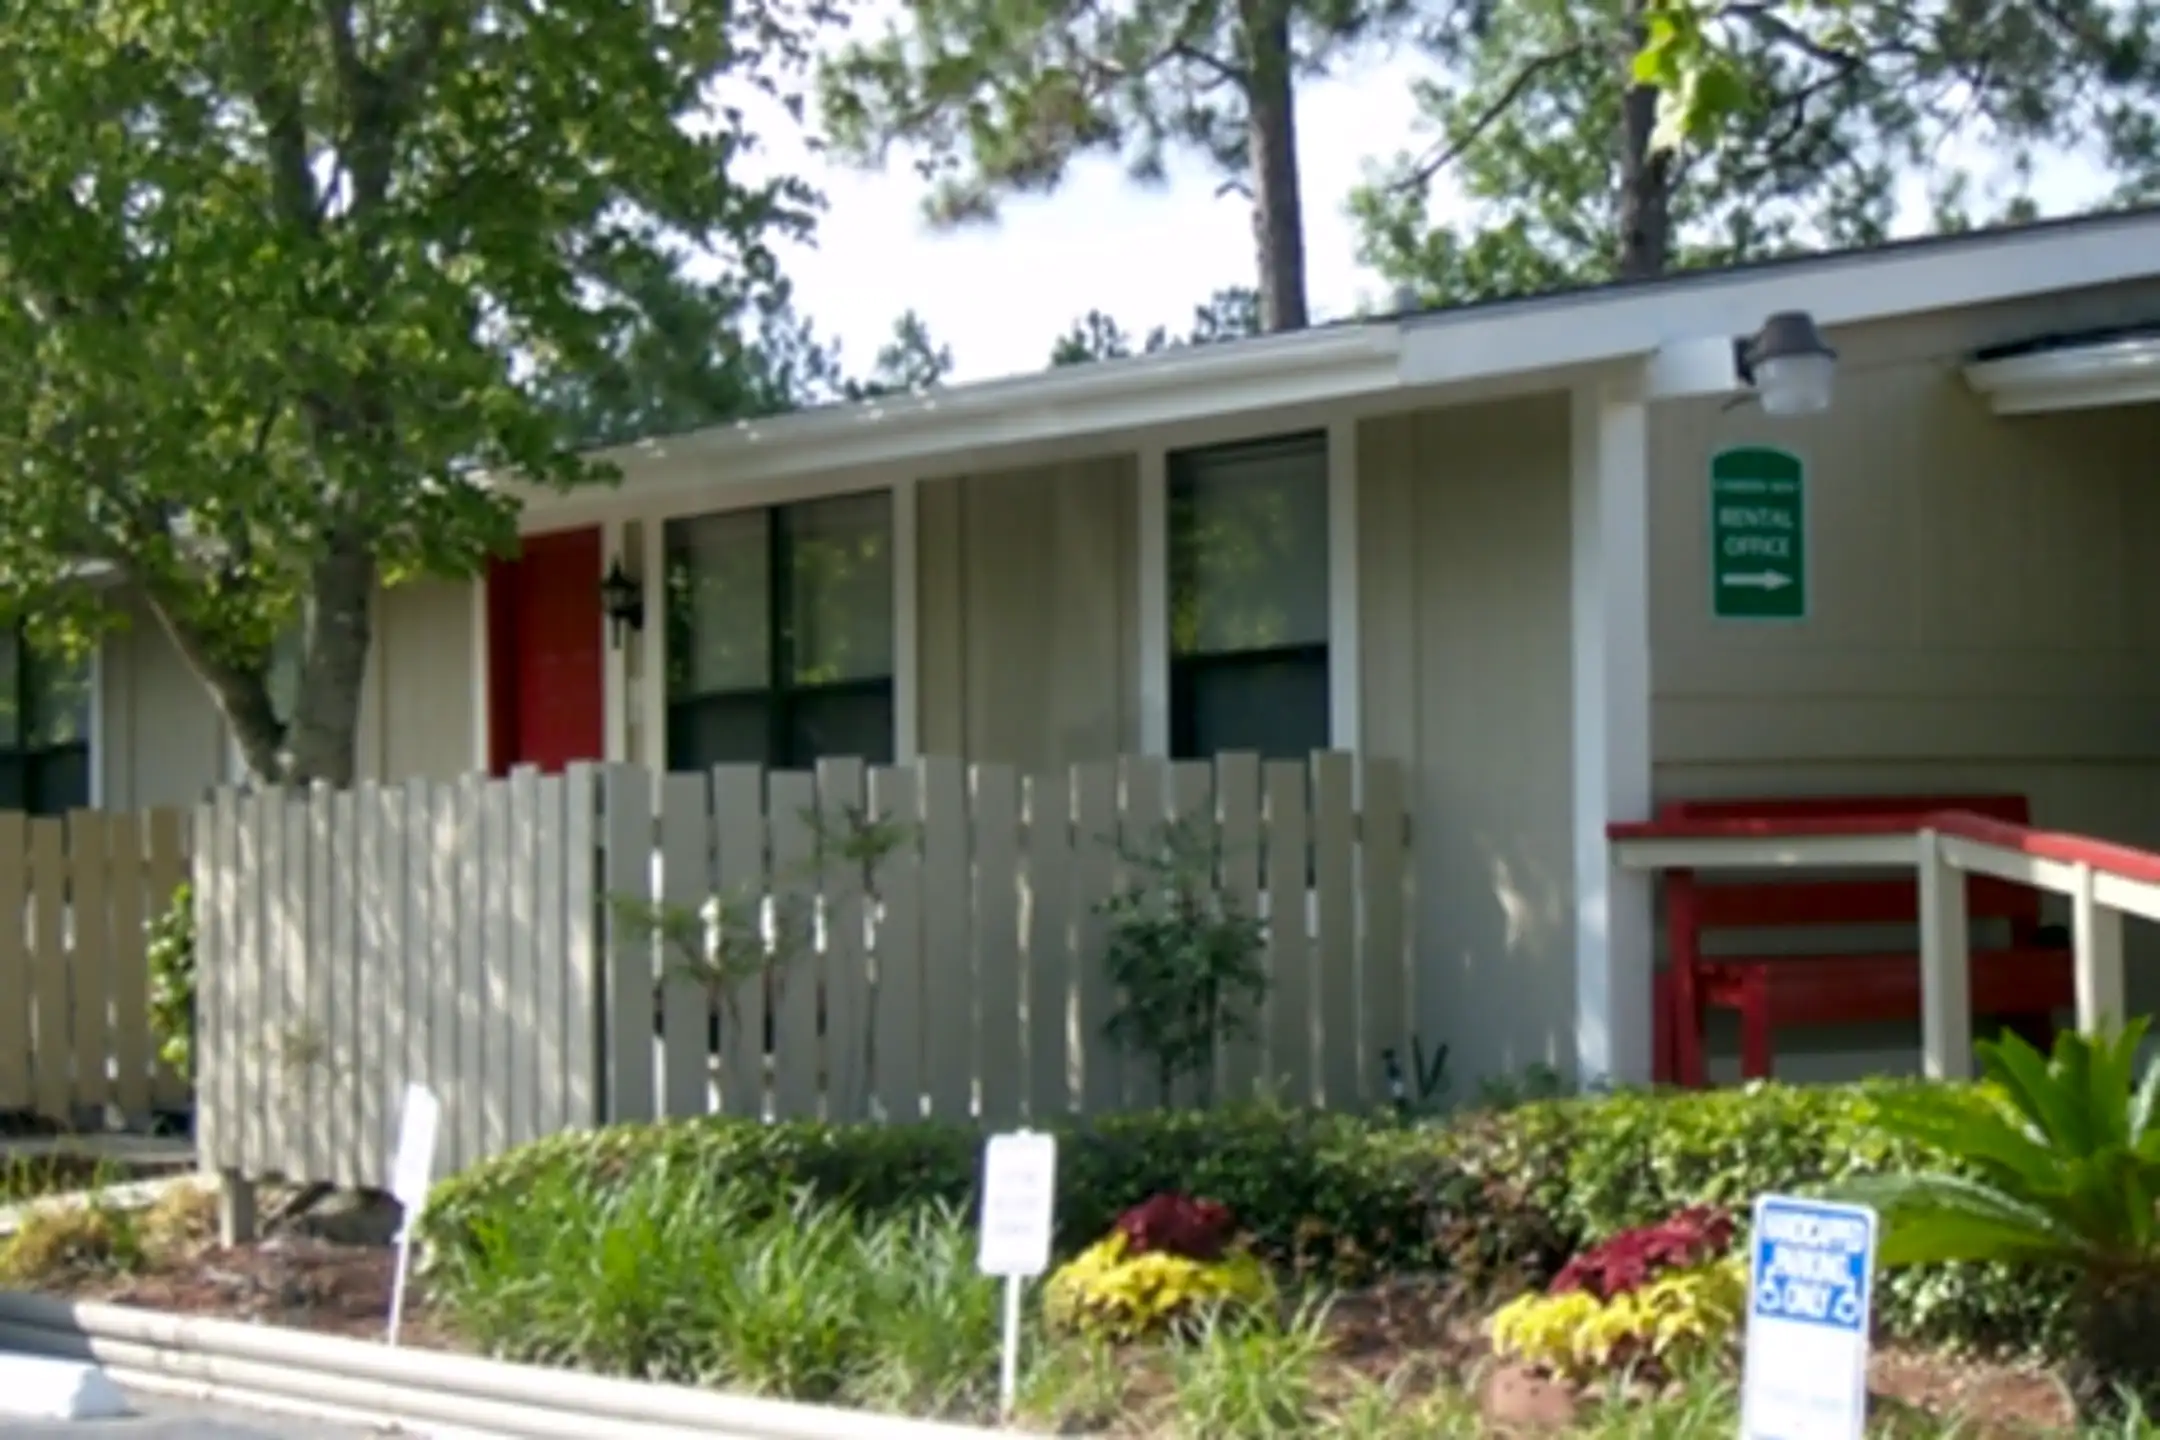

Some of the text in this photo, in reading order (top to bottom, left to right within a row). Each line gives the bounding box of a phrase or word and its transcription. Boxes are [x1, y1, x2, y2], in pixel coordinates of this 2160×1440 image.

[1719, 506, 1793, 528] RENTAL
[1723, 535, 1790, 557] OFFICE
[1773, 1245, 1850, 1285] PARKING
[1784, 1279, 1831, 1319] ONLY
